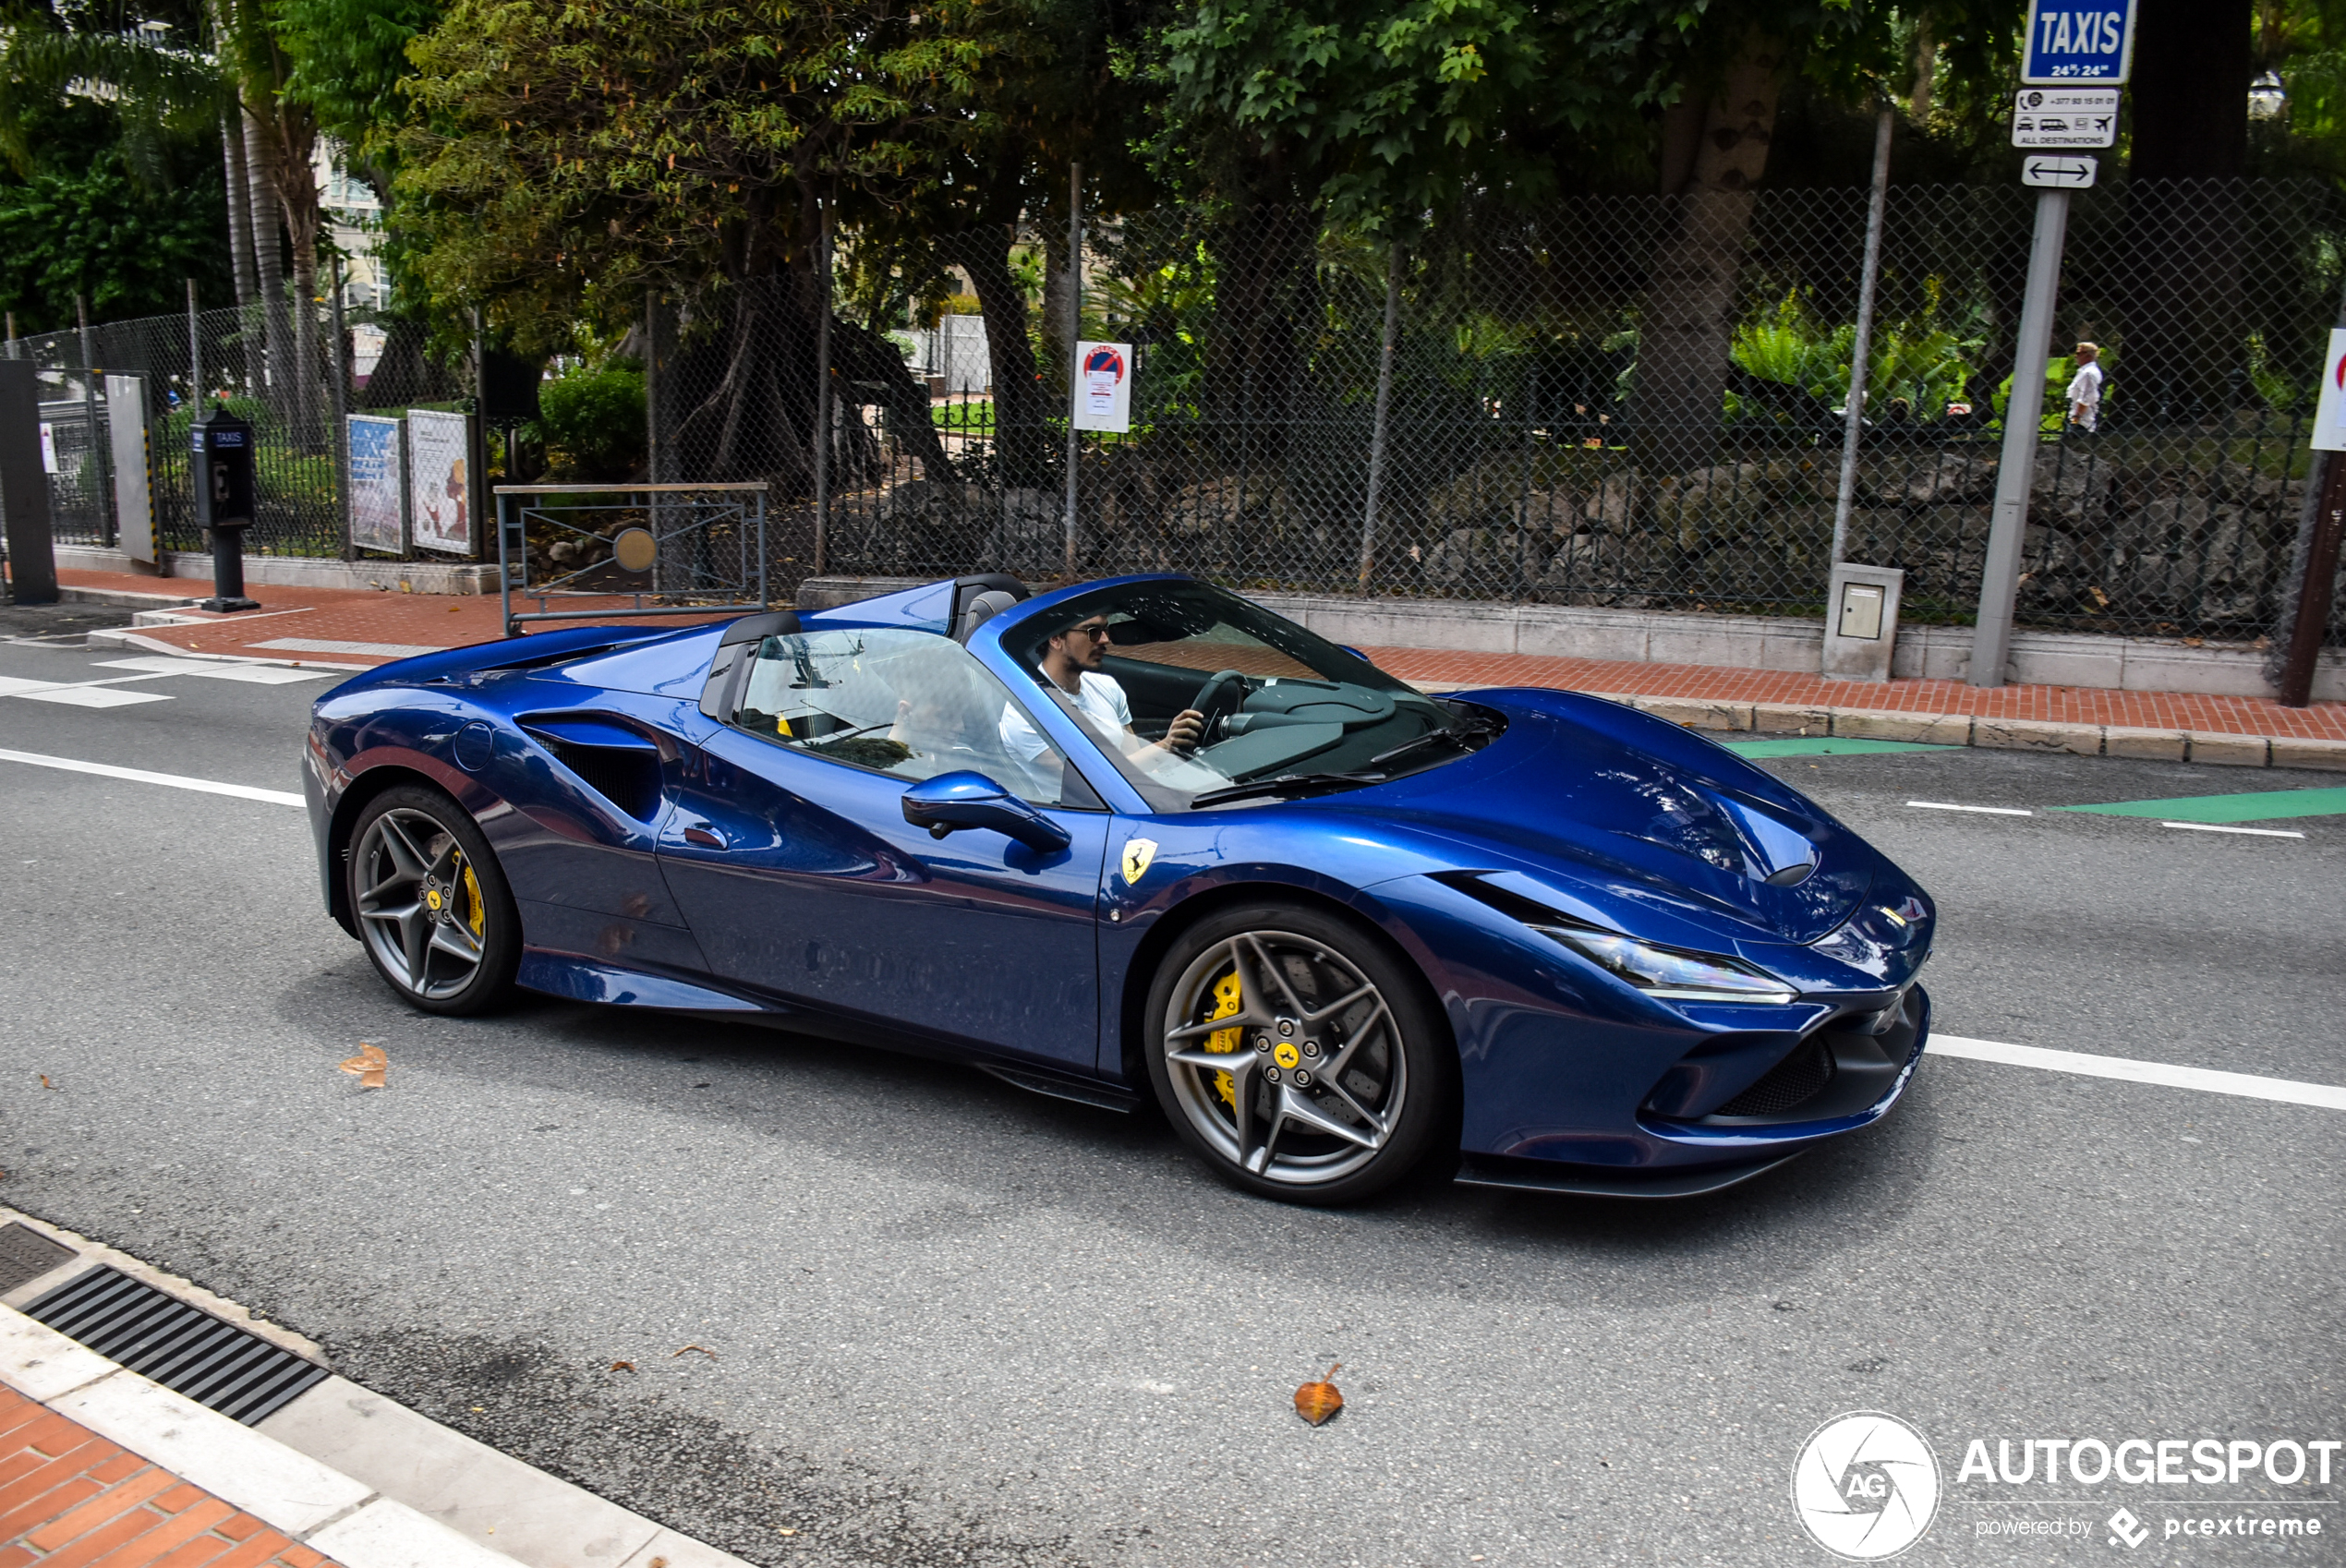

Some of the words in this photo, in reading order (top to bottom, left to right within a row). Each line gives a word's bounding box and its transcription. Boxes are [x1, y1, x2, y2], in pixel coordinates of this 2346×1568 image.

[2040, 11, 2121, 54] TAXIS
[2039, 137, 2105, 145] DESTINATIONS
[1089, 346, 1120, 359] POLICE
[215, 431, 242, 442] TAXIS
